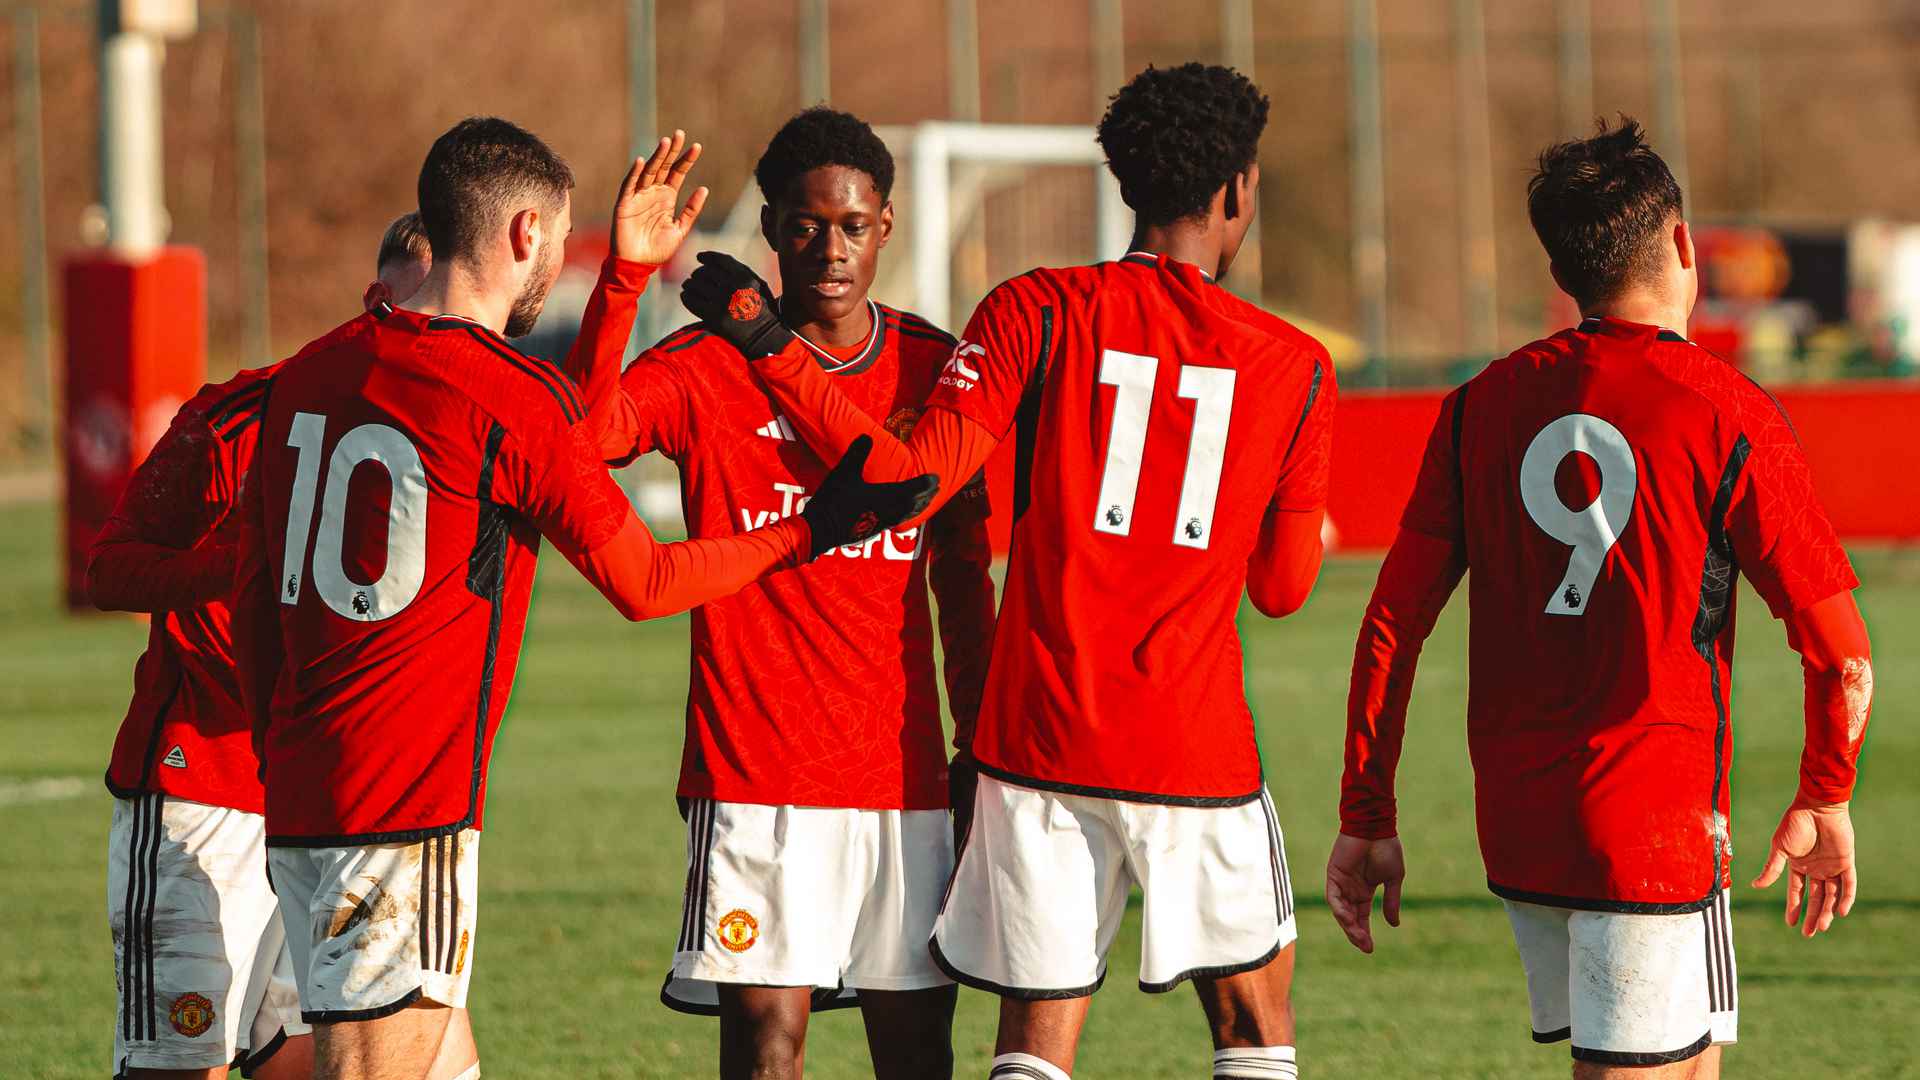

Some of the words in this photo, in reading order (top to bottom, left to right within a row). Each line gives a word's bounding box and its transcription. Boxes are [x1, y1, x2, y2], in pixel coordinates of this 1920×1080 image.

[281, 412, 428, 621] 10
[1094, 348, 1236, 549] 11
[1520, 414, 1636, 615] 9
